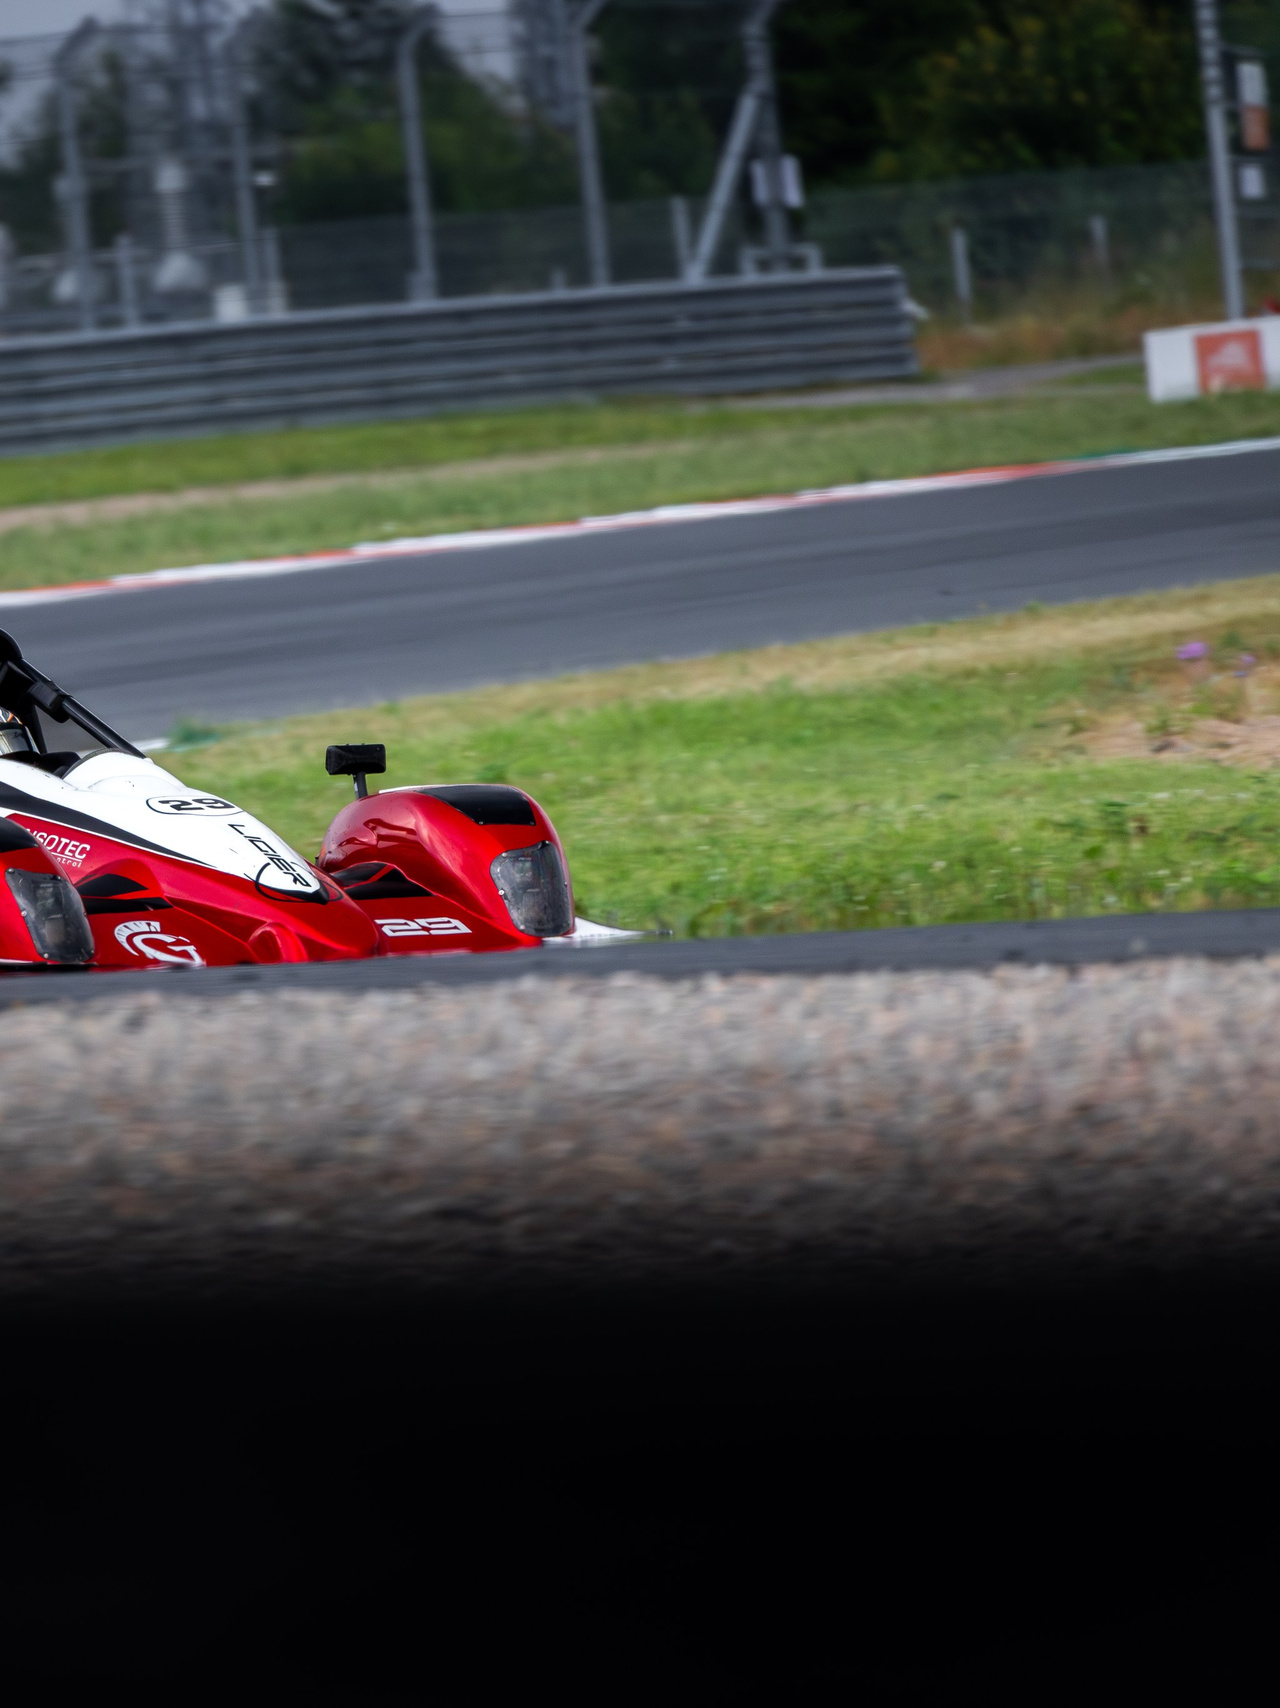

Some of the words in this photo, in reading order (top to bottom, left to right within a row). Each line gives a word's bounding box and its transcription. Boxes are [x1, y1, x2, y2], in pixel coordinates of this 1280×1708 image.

[158, 798, 236, 812] 29
[227, 823, 313, 888] LIGIER
[373, 916, 473, 937] 29
